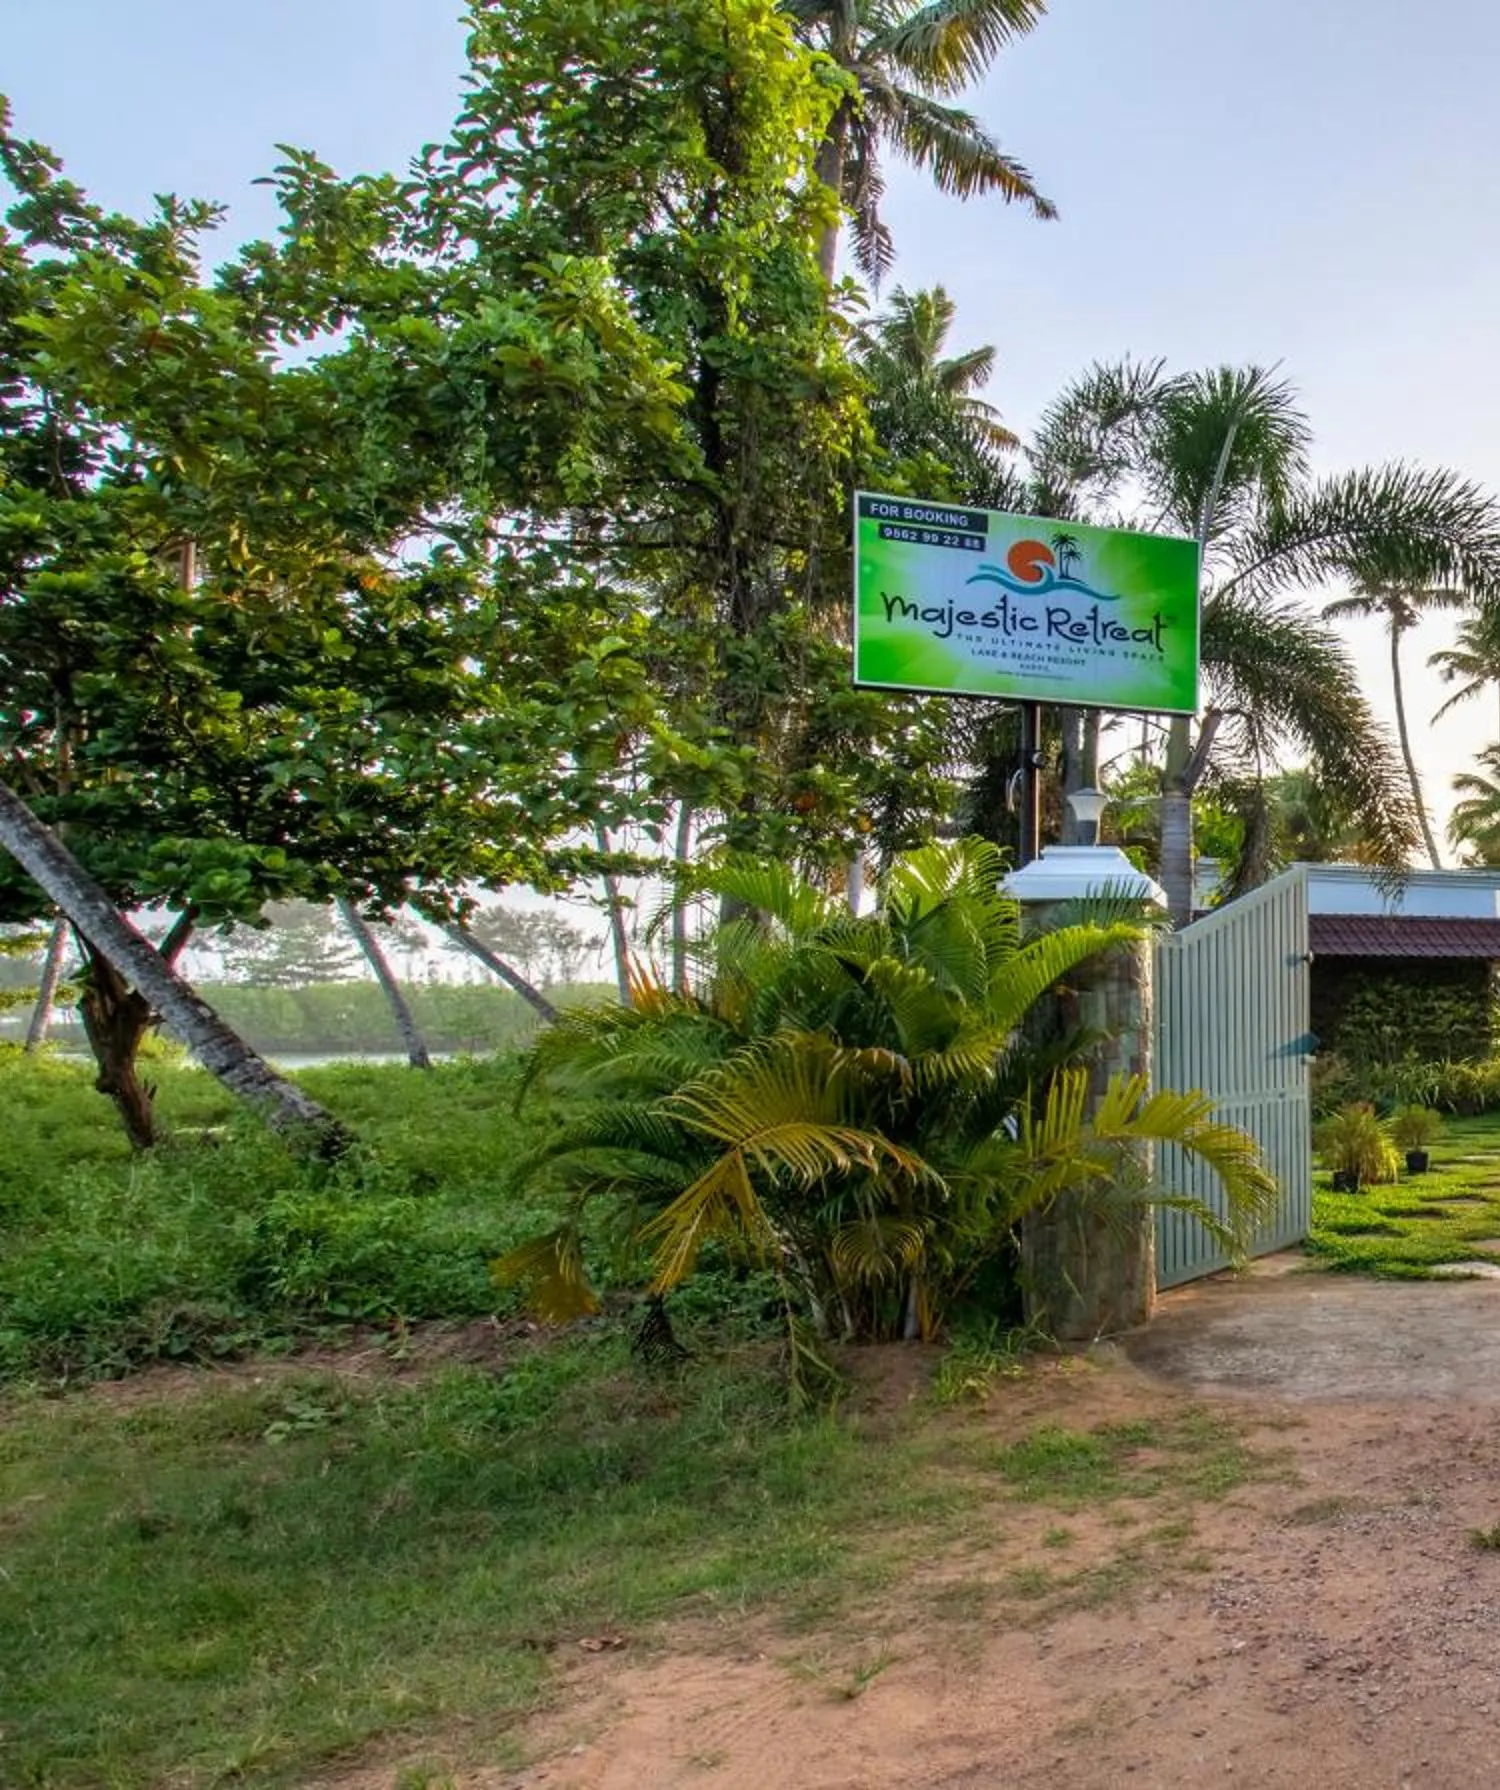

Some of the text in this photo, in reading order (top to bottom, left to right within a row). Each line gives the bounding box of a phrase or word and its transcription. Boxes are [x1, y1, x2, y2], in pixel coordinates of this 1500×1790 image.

[870, 503, 969, 527] FOR BOOKING
[943, 535, 960, 546] 22
[880, 591, 1168, 652] Majestic Retreat
[957, 633, 983, 643] THE
[991, 637, 1060, 651] ULTIMATE
[1069, 646, 1115, 657] LIVING
[971, 648, 998, 658] LAKE
[1011, 652, 1045, 662] BEACH
[1047, 655, 1086, 666] RESORT
